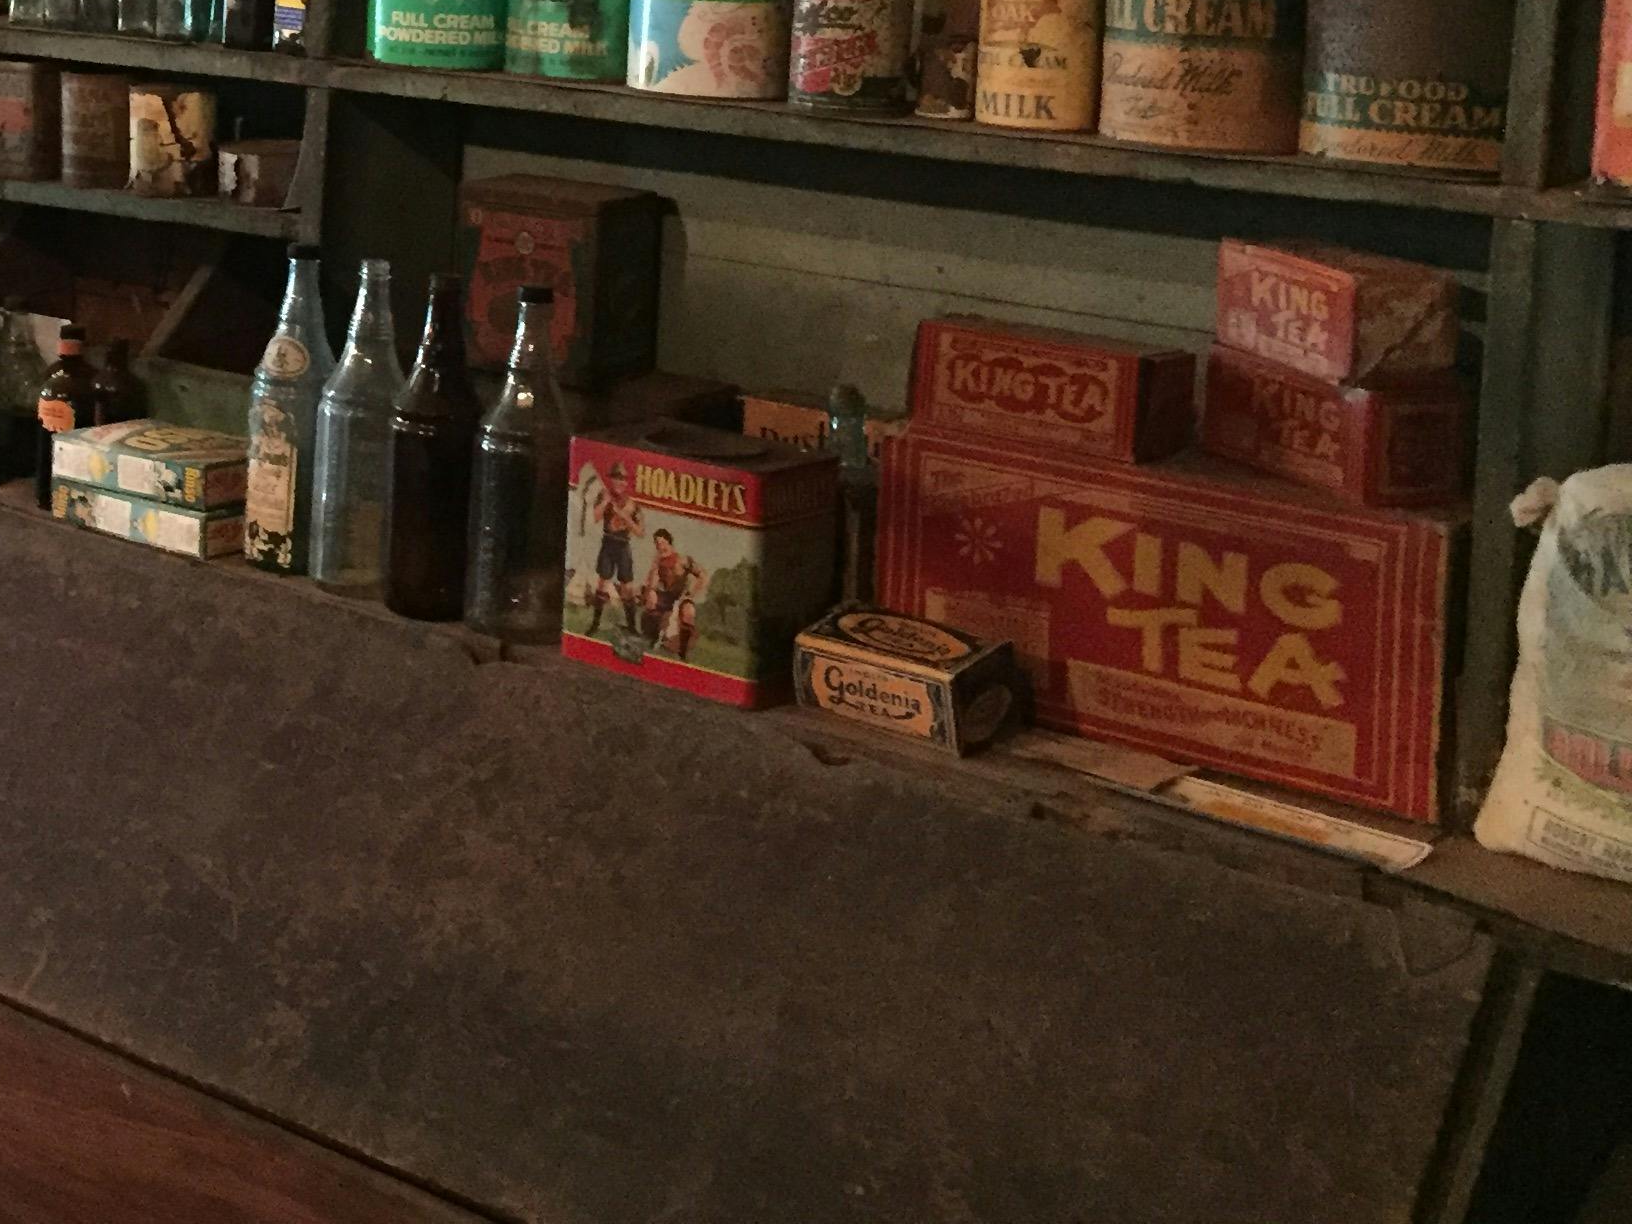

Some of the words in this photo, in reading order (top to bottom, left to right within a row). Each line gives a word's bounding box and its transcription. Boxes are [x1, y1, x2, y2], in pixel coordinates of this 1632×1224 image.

[378, 25, 471, 45] POWDERED
[391, 10, 429, 28] FULL
[433, 12, 497, 31] CREAM
[979, 89, 1057, 121] MILK
[1368, 98, 1503, 131] CREAM
[1250, 267, 1329, 321] KING
[1271, 309, 1329, 353] TEA
[953, 358, 1036, 402] KING
[1037, 376, 1105, 418] TEA
[1280, 424, 1341, 459] TEA
[635, 464, 746, 515] HOADLEYS
[1034, 503, 1344, 632] KING
[1105, 605, 1348, 708] TEA
[824, 665, 923, 716] Goldenia
